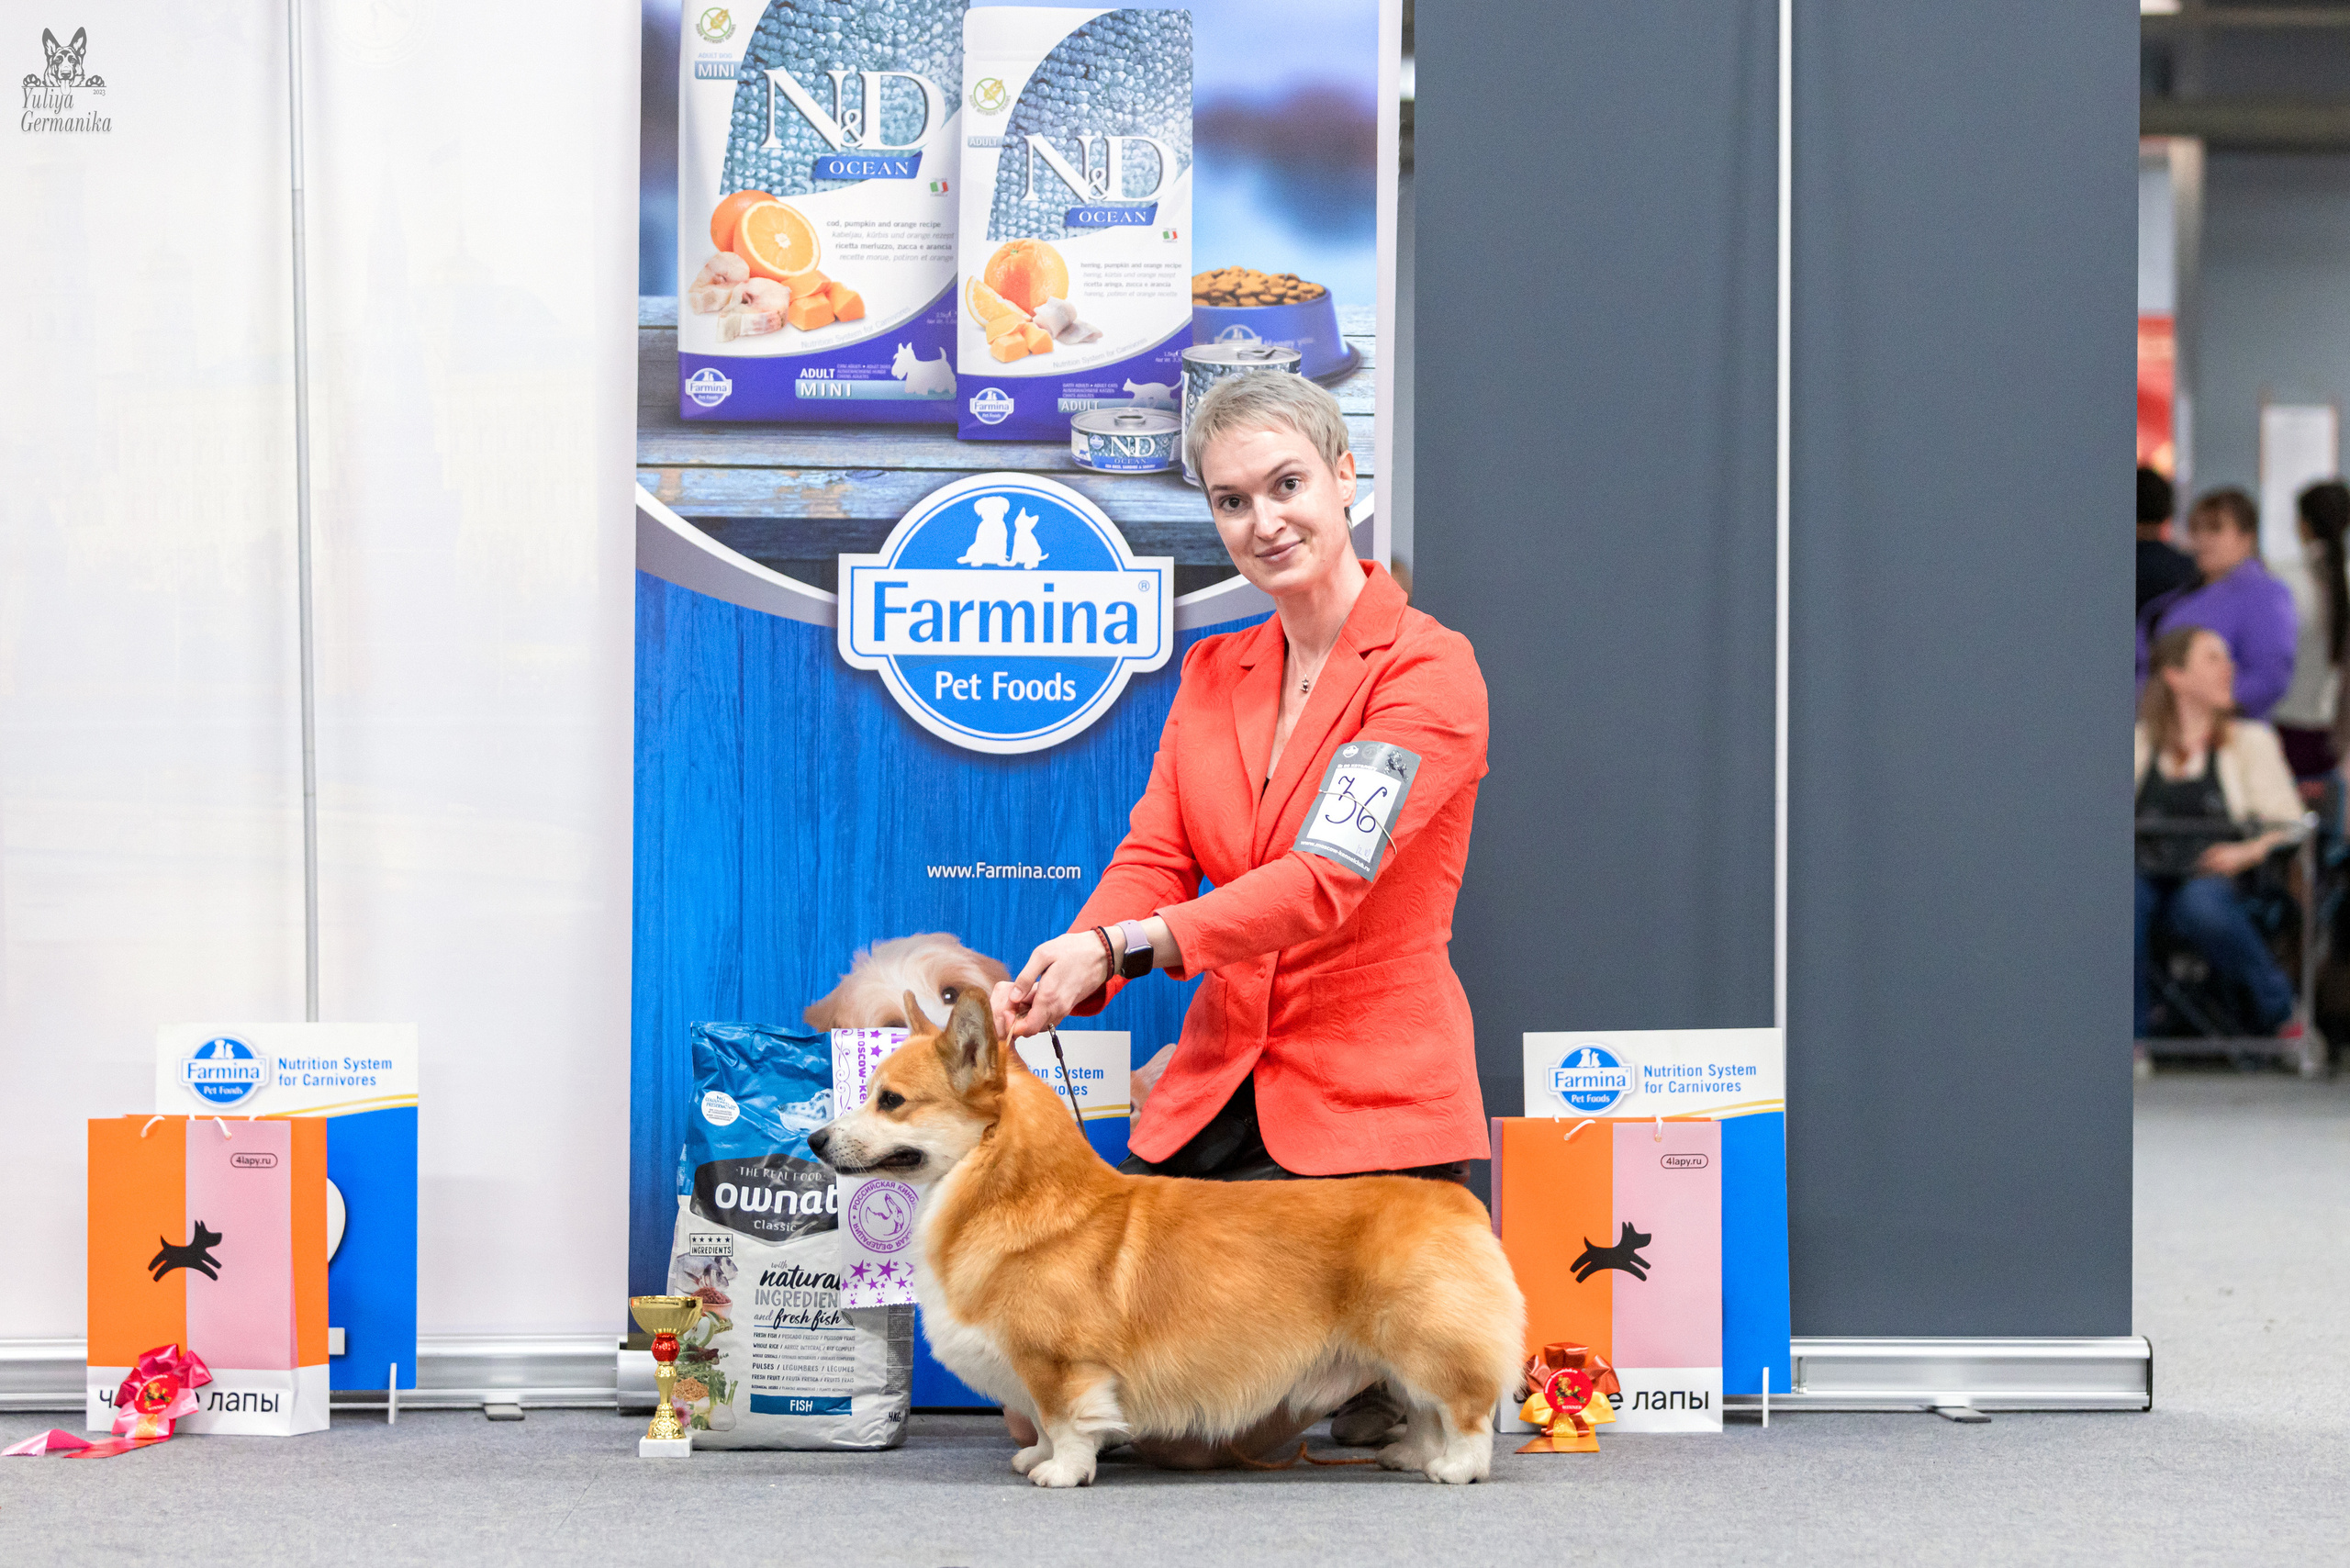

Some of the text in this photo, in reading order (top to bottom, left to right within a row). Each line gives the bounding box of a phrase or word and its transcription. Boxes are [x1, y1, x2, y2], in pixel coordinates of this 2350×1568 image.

[699, 63, 734, 77] MINI
[969, 138, 998, 147] ADULT
[829, 160, 909, 175] OCEAN
[1079, 210, 1147, 223] OCEAN
[826, 219, 942, 230] cod, pumpkin and orange recipe
[890, 230, 905, 239] und
[907, 233, 930, 241] orange
[860, 242, 895, 252] merluzzo,
[839, 252, 865, 261] recette
[893, 253, 918, 263] potiron
[920, 253, 928, 262] et
[930, 254, 954, 263] orange
[800, 368, 834, 379] ADULT
[690, 382, 727, 392] Farmina
[800, 382, 852, 397] MINI
[974, 401, 1009, 410] Farmina
[1061, 400, 1100, 411] ADULT
[873, 581, 1137, 644] Farmina
[935, 671, 1077, 700] Pet Foods
[1325, 776, 1388, 833] 36
[926, 862, 1081, 879] www.Farmina.com
[187, 1062, 260, 1079] Farmina
[278, 1057, 393, 1072] Nutrition System
[1644, 1063, 1757, 1079] Nutrition System
[279, 1073, 376, 1086] for Carnivores
[1554, 1070, 1626, 1088] Farmina
[204, 1085, 243, 1094] Pet Foods
[1644, 1080, 1741, 1093] for Carnivores
[1572, 1093, 1610, 1103] Pet Foods
[236, 1156, 272, 1166] 4lapy.ru
[1666, 1157, 1702, 1166] 4lapy.ru
[739, 1166, 822, 1182] THE REAL FOOD
[715, 1182, 838, 1215] ownat
[853, 1181, 896, 1210] РОССИЙСКАЯ
[754, 1219, 797, 1232] Classic
[853, 1223, 893, 1250] ФЕДЕРАЦИЯ
[691, 1246, 732, 1255] INGREDIENTS
[771, 1260, 788, 1269] with
[755, 1289, 838, 1308] INGREDIEN
[754, 1308, 842, 1331] and fresh fish
[783, 1364, 819, 1372] LEGUMBRES
[207, 1392, 279, 1413] лапы
[790, 1400, 813, 1412] FISH
[1632, 1391, 1709, 1411] лапы
